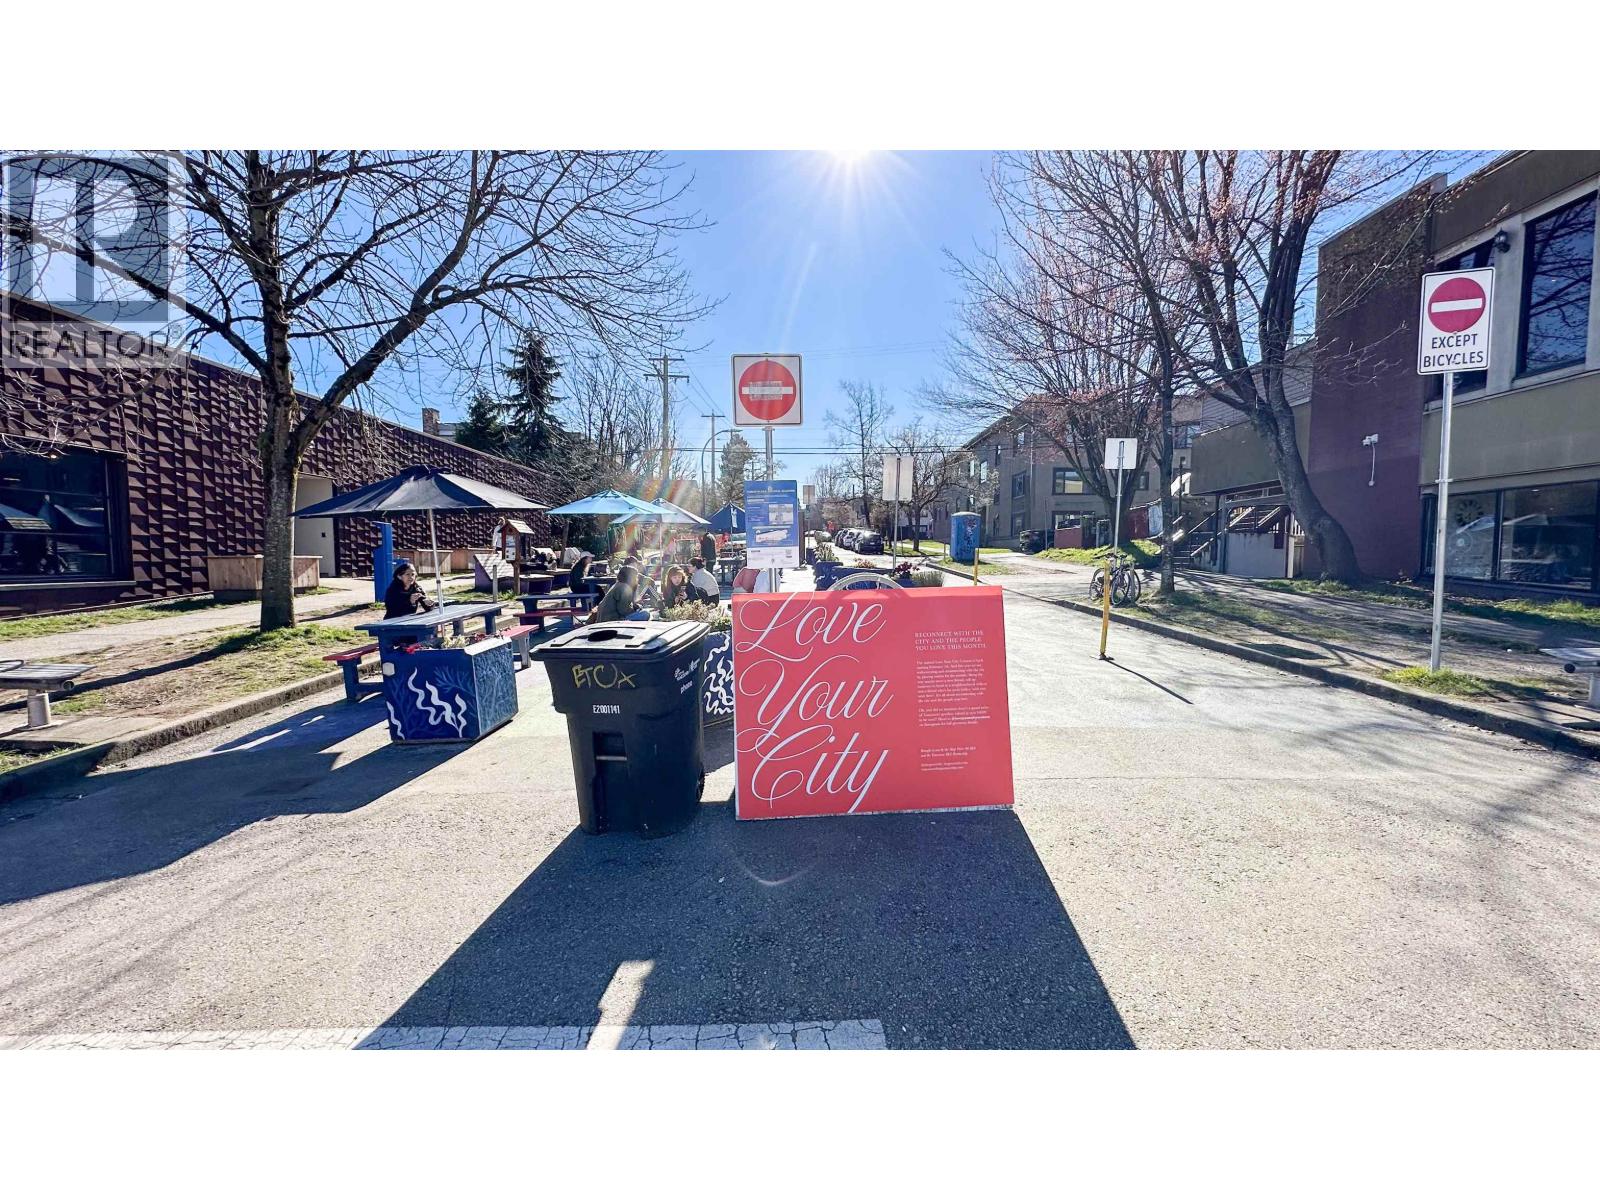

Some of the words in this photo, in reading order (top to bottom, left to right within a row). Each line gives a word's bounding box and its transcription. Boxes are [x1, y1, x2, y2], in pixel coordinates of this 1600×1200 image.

[1423, 350, 1484, 368] BICYCLES
[1431, 333, 1478, 349] EXCEPT
[735, 591, 888, 662] Love
[592, 704, 620, 714] E2001141
[735, 654, 894, 752] Your
[750, 724, 889, 814] City
